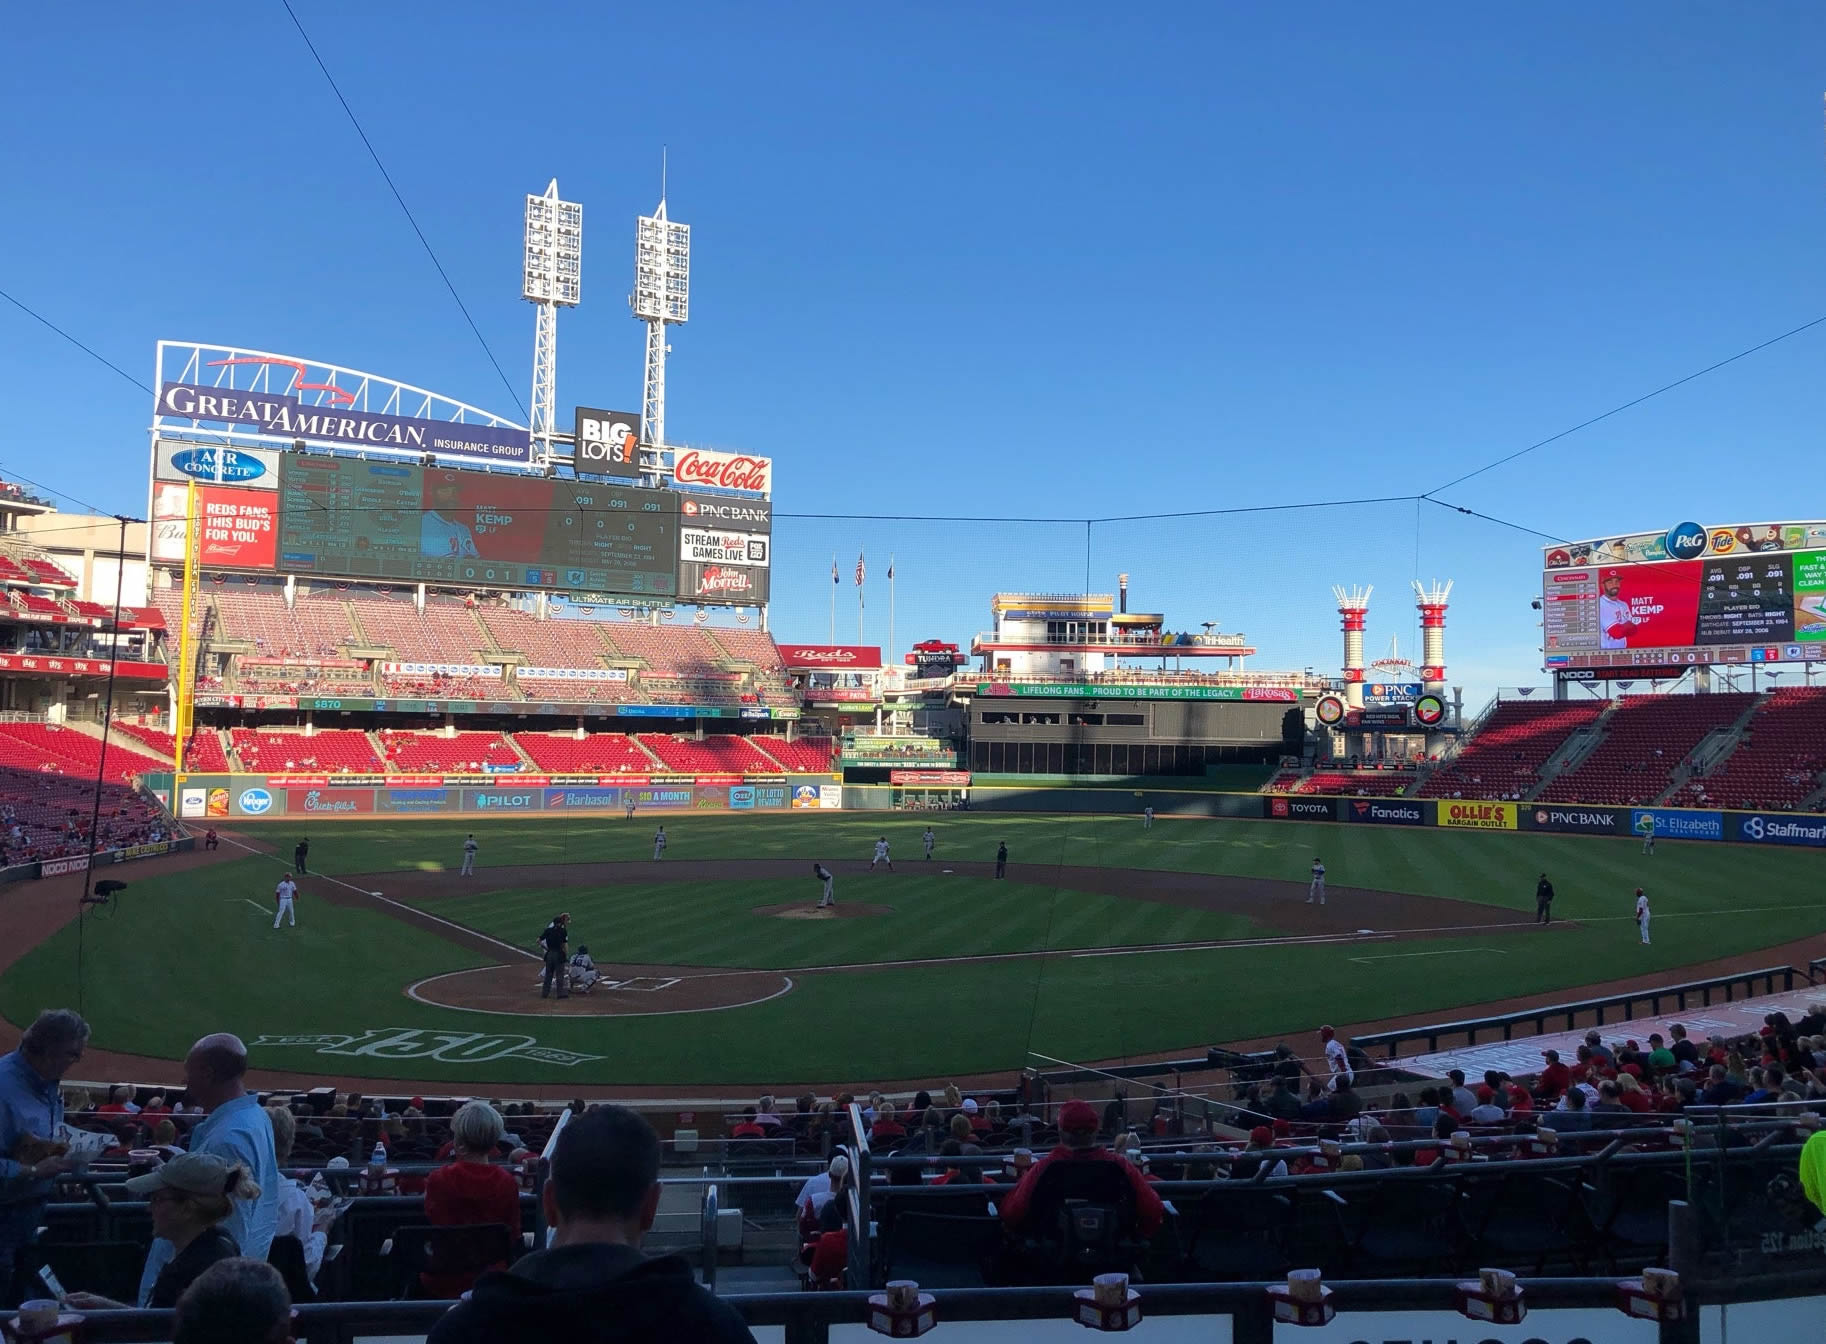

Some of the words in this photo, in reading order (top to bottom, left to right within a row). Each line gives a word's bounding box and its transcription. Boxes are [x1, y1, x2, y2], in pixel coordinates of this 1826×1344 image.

[582, 418, 632, 445] BIG
[434, 439, 489, 453] INSURANCE
[491, 442, 524, 456] GROUP
[675, 451, 770, 492] Coca-Cola
[207, 503, 236, 515] REDS
[239, 506, 272, 520] FANS,
[208, 517, 232, 528] THIS
[236, 518, 271, 531] BUD'S
[475, 513, 513, 526] KEMP
[206, 529, 229, 541] FOR
[231, 530, 259, 543] YOU.
[684, 534, 720, 547] STREAM
[721, 536, 746, 549] Reds
[1675, 533, 1704, 548] P&G
[1711, 534, 1734, 551] Tide
[692, 547, 723, 559] GAMES
[724, 549, 743, 561] LIVE
[465, 568, 474, 578] 0
[485, 569, 495, 579] 0
[717, 567, 739, 578] John
[1799, 564, 1818, 572] FAST
[1707, 574, 1725, 582] .091
[1736, 572, 1753, 580] .091
[1765, 570, 1783, 578] .091
[1804, 572, 1822, 580] WAY
[697, 575, 752, 593] Morrell
[1798, 580, 1825, 588] CLEAN
[1778, 587, 1783, 595] 1
[571, 595, 614, 604] ULTIMATE
[614, 598, 630, 606] AIR
[631, 599, 671, 608] SHUTTLE
[1631, 596, 1654, 605] MATT
[1631, 604, 1664, 616] KEMP
[1204, 635, 1245, 646] TriHealth
[793, 648, 857, 662] Reds
[917, 654, 951, 664] TUNDRA
[1672, 653, 1680, 662] 0
[1688, 653, 1695, 662] 0
[1703, 653, 1709, 662] 1
[1559, 670, 1595, 680] NOCO
[1023, 686, 1063, 695] LIFELONG
[1092, 687, 1122, 696] PROUD
[1124, 688, 1135, 696] TO
[1137, 688, 1147, 697] BE
[1149, 688, 1169, 697] PART
[1171, 689, 1183, 697] OF
[1184, 689, 1199, 697] THE
[1384, 684, 1412, 696] PNC
[314, 700, 341, 709] $870
[210, 792, 229, 803] Kahn's
[566, 791, 612, 807] Barbasol
[653, 791, 660, 801] A
[660, 791, 690, 801] MONTH
[766, 788, 784, 798] LOTTO
[243, 792, 270, 810] Kroger
[486, 795, 531, 806] PILOT
[1290, 803, 1329, 814] TOYOTA
[1371, 805, 1420, 820] Fanatics
[1447, 818, 1479, 828] BARGAIN
[1480, 820, 1508, 829] OUTLET
[1669, 818, 1720, 832] Elizabeth
[42, 862, 68, 876] NOCO
